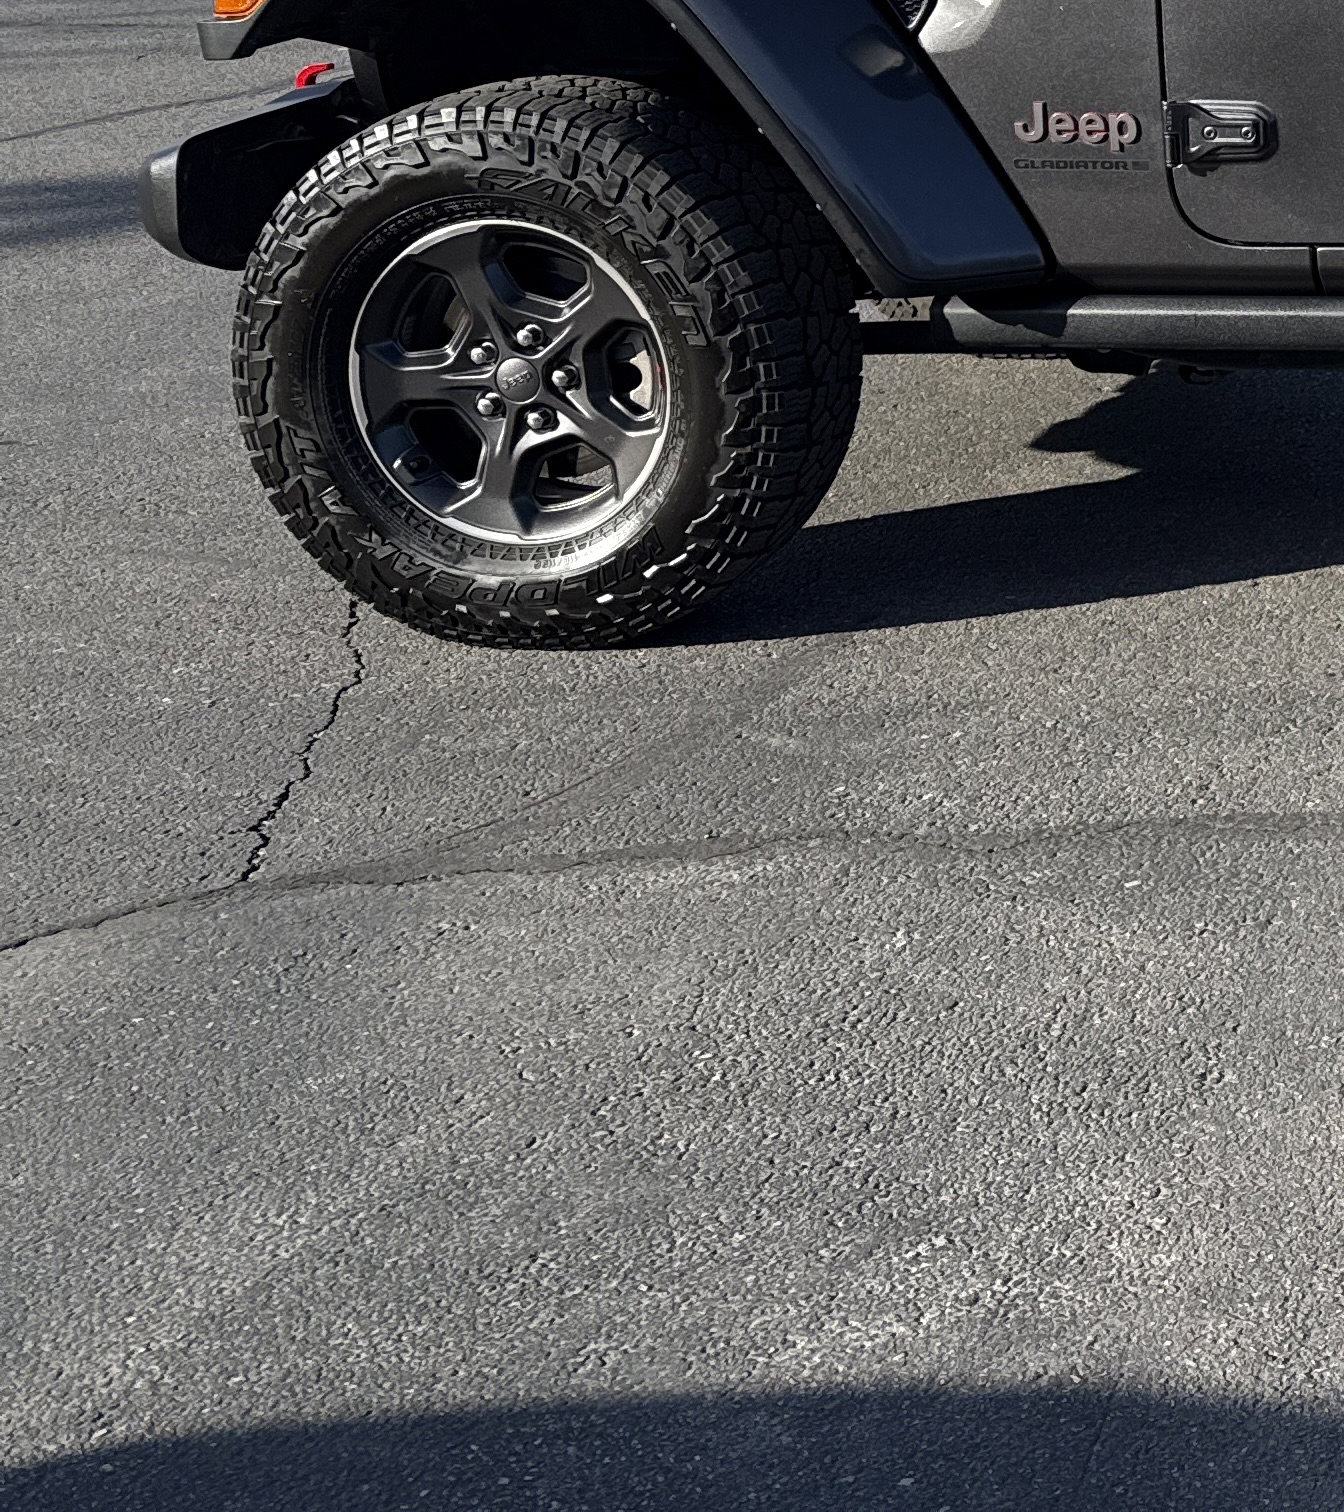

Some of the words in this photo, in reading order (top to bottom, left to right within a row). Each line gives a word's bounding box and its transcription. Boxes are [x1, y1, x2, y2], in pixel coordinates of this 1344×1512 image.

[1013, 100, 1141, 152] Jeep
[1013, 159, 1129, 170] GLADIATOR
[350, 522, 665, 609] WILDPEAK
